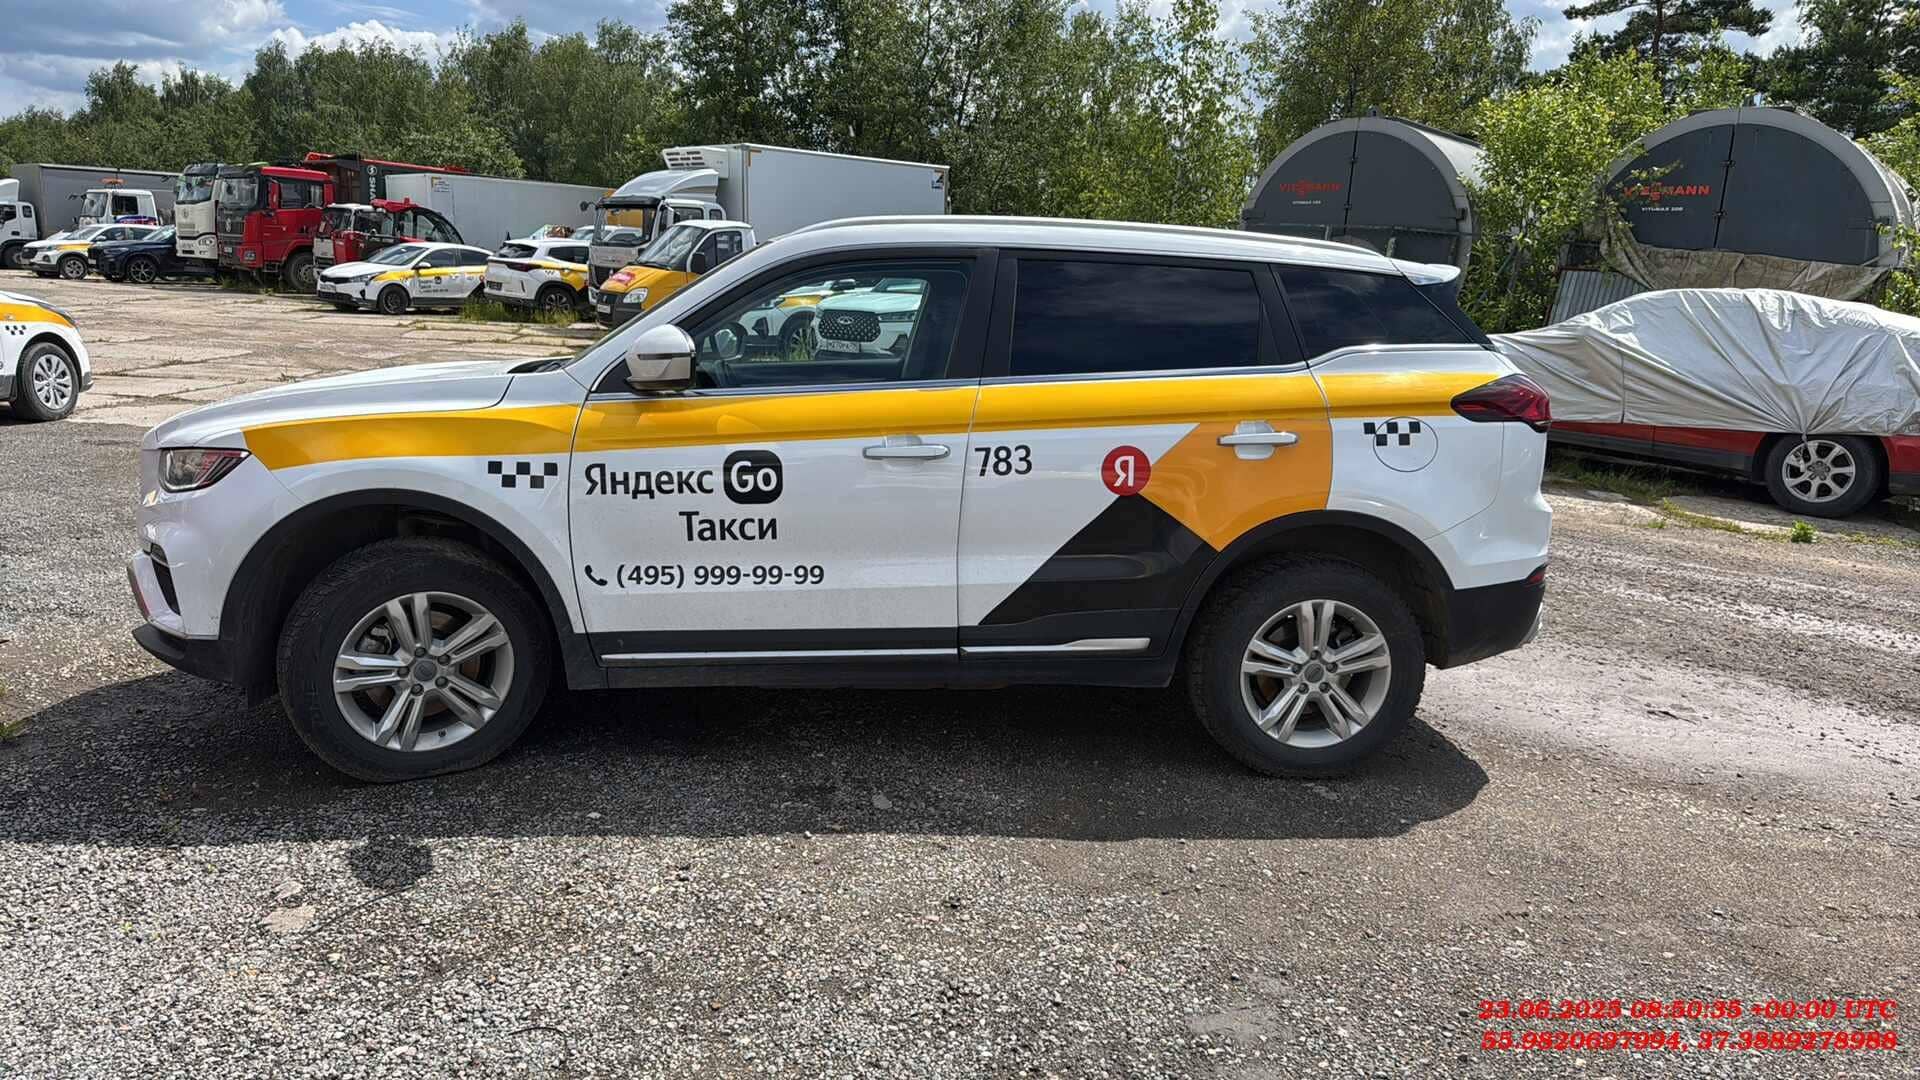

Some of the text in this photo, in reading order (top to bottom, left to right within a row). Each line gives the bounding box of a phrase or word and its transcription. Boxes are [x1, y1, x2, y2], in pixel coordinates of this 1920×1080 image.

[974, 444, 1033, 477] 783
[1113, 455, 1135, 487] Я
[584, 459, 779, 499] Яндекс Go
[679, 511, 778, 541] Такси
[616, 563, 825, 588] (495) 999-99-99
